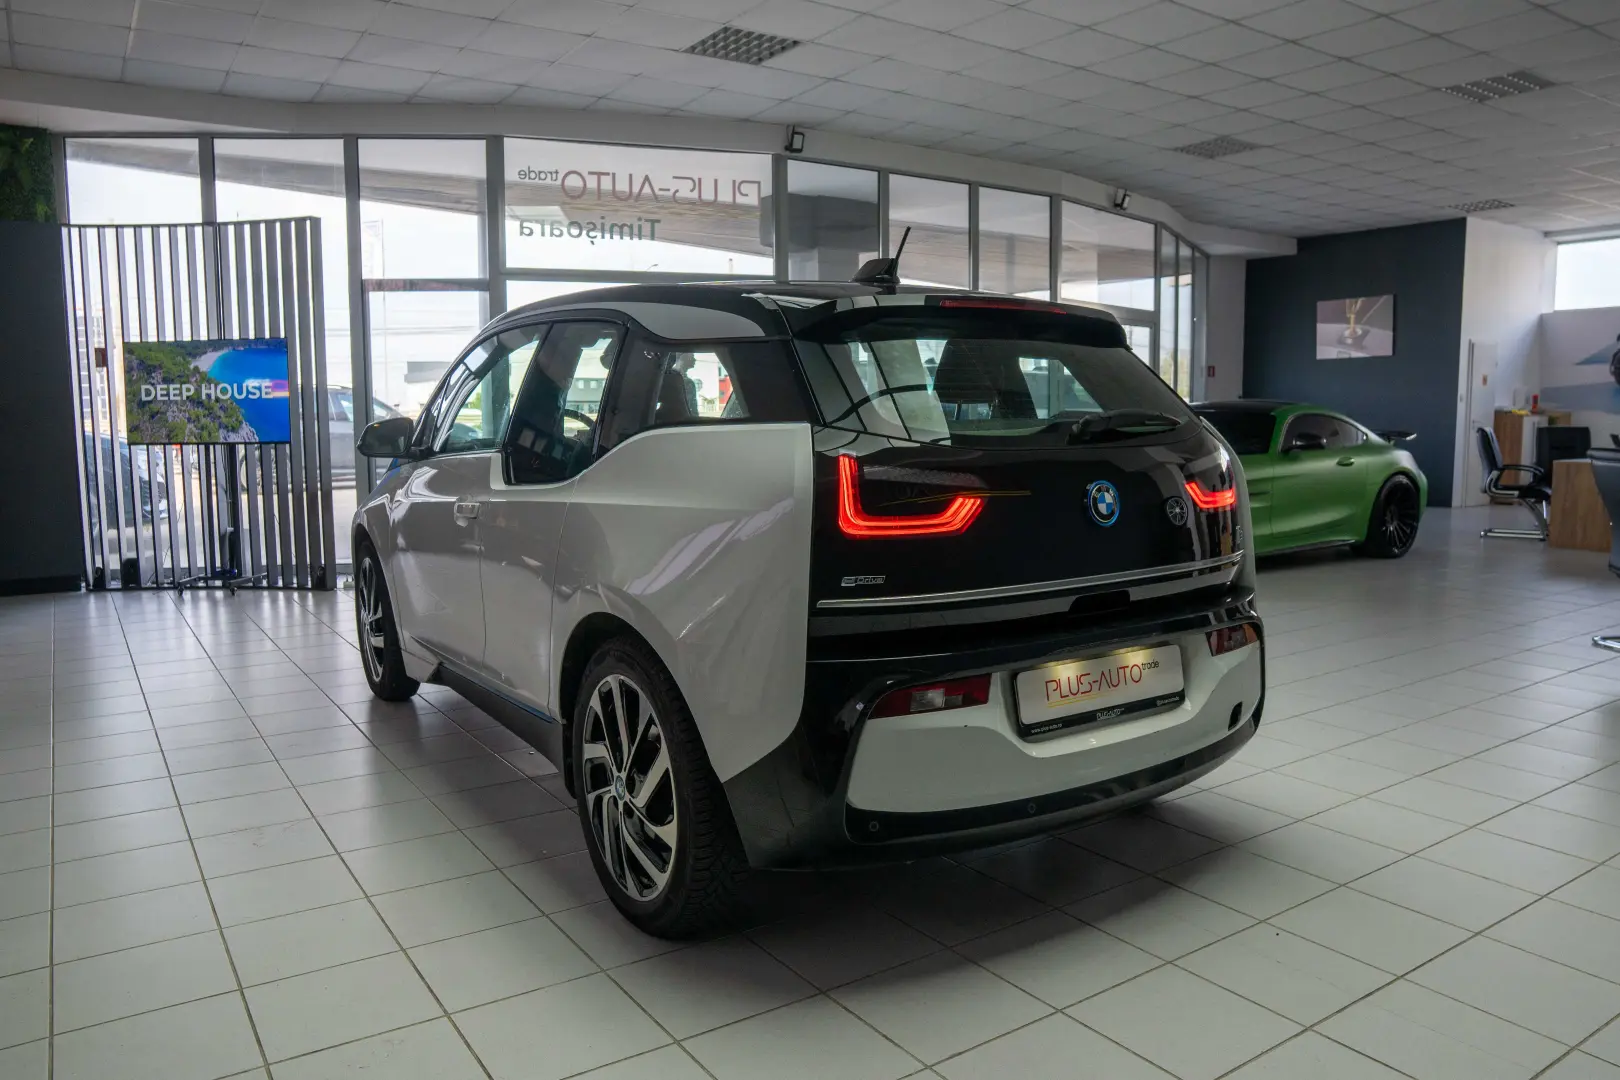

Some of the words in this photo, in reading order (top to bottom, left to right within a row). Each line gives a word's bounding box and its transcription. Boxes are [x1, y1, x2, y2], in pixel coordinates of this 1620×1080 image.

[140, 383, 195, 402] DEEP
[201, 381, 274, 400] HOUSE
[1045, 663, 1143, 701] PLUS-AUTO
[1141, 659, 1160, 671] trade
